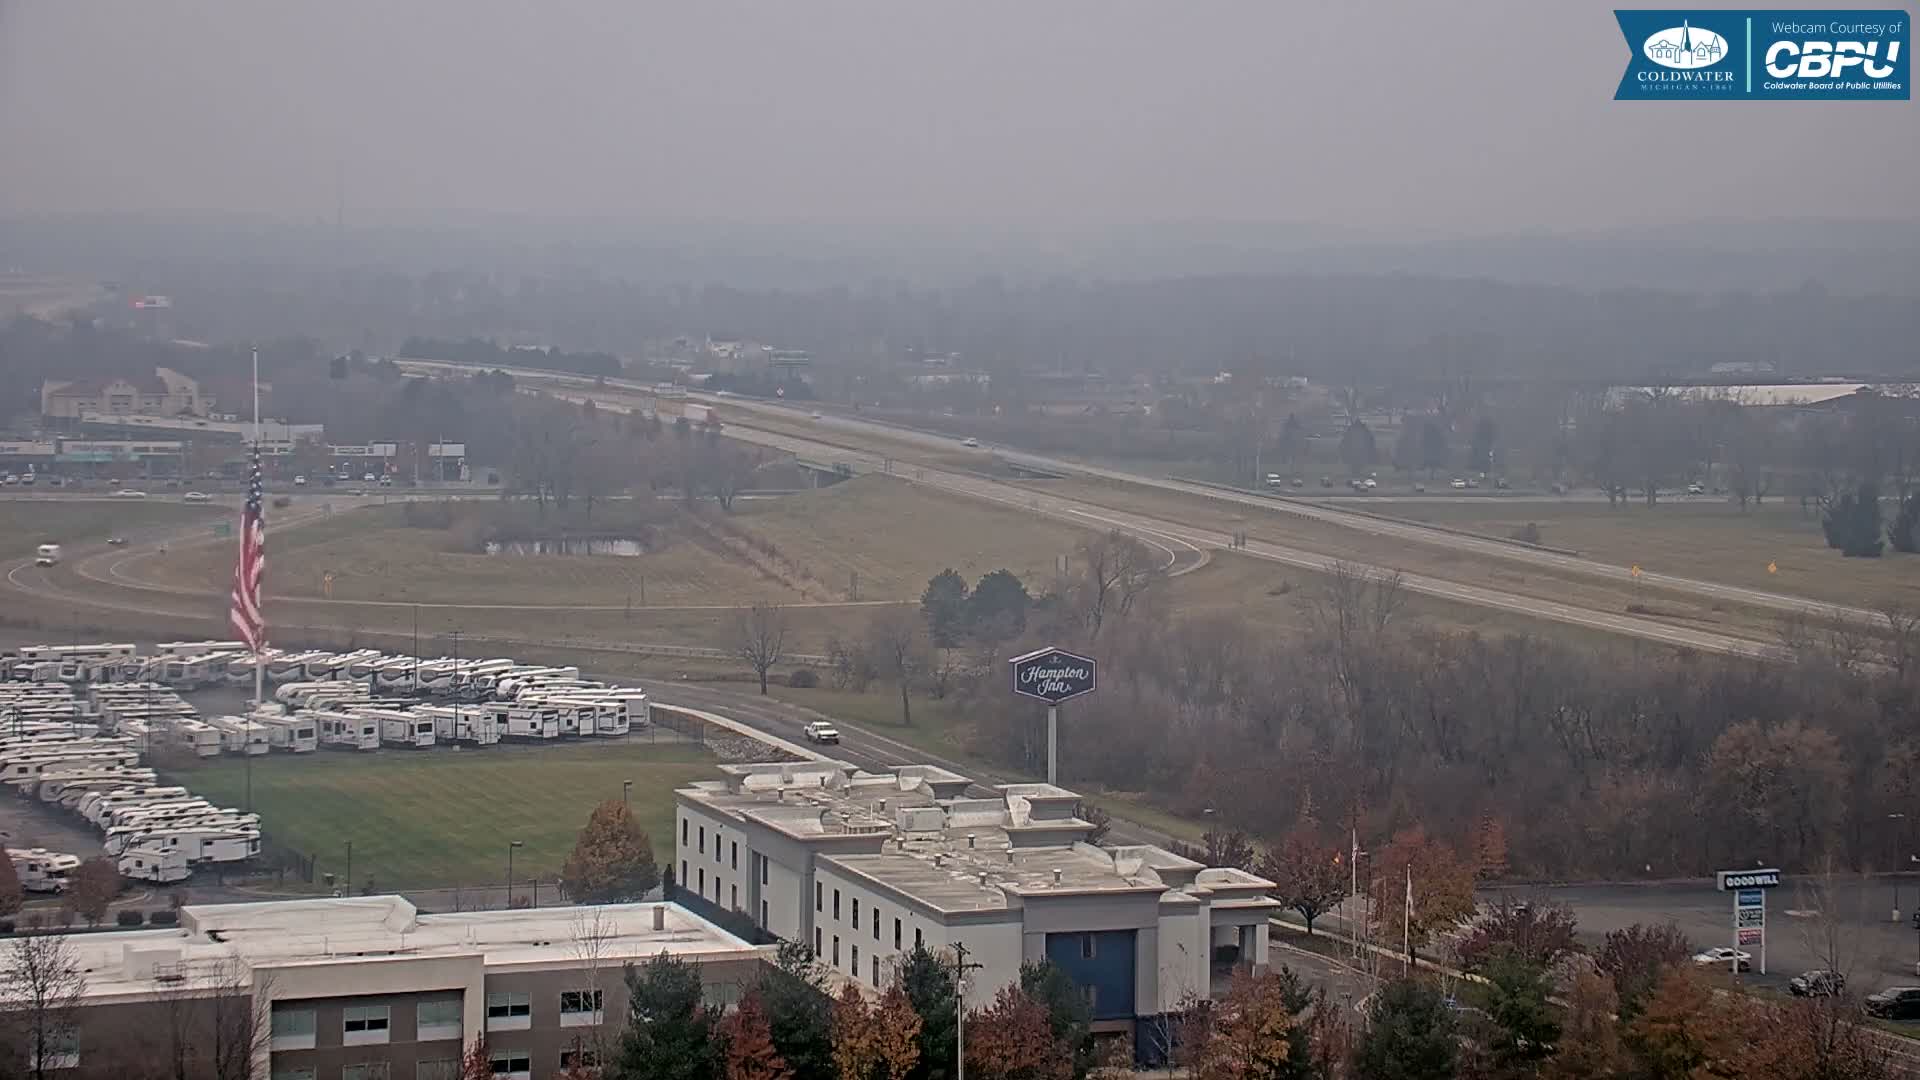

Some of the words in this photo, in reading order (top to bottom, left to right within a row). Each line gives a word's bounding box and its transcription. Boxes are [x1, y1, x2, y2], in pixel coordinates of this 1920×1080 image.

[1020, 666, 1089, 683] Hampton
[1037, 679, 1070, 696] Inn
[1726, 875, 1779, 887] GOODWILL
